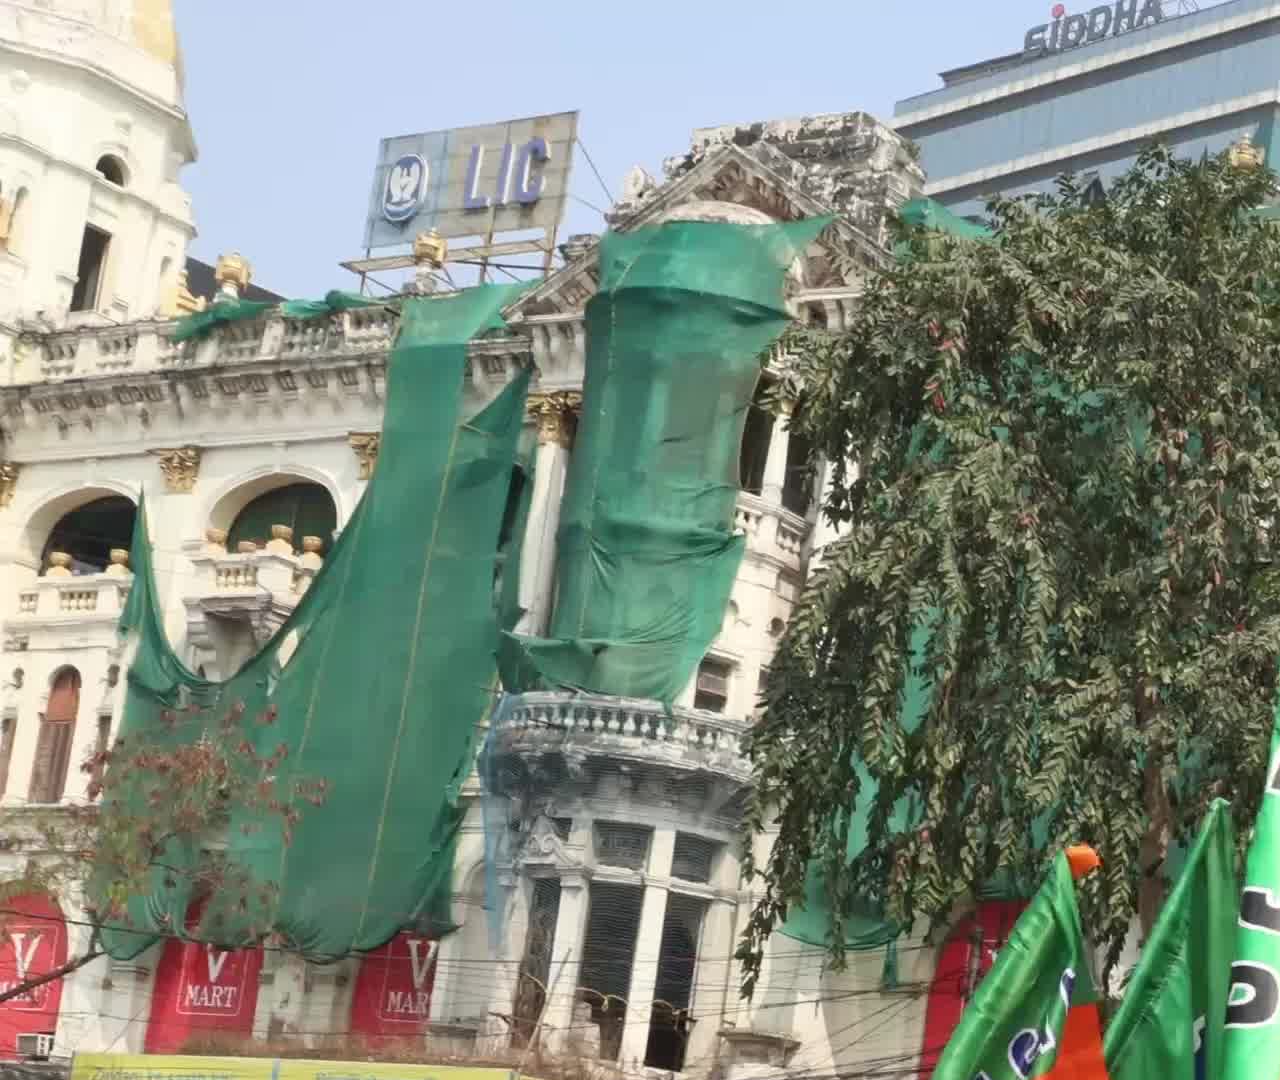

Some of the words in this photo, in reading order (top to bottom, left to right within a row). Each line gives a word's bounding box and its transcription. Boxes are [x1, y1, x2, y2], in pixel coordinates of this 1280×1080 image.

[464, 138, 551, 209] LIC
[184, 984, 237, 1009] MART
[386, 990, 430, 1013] MAR
